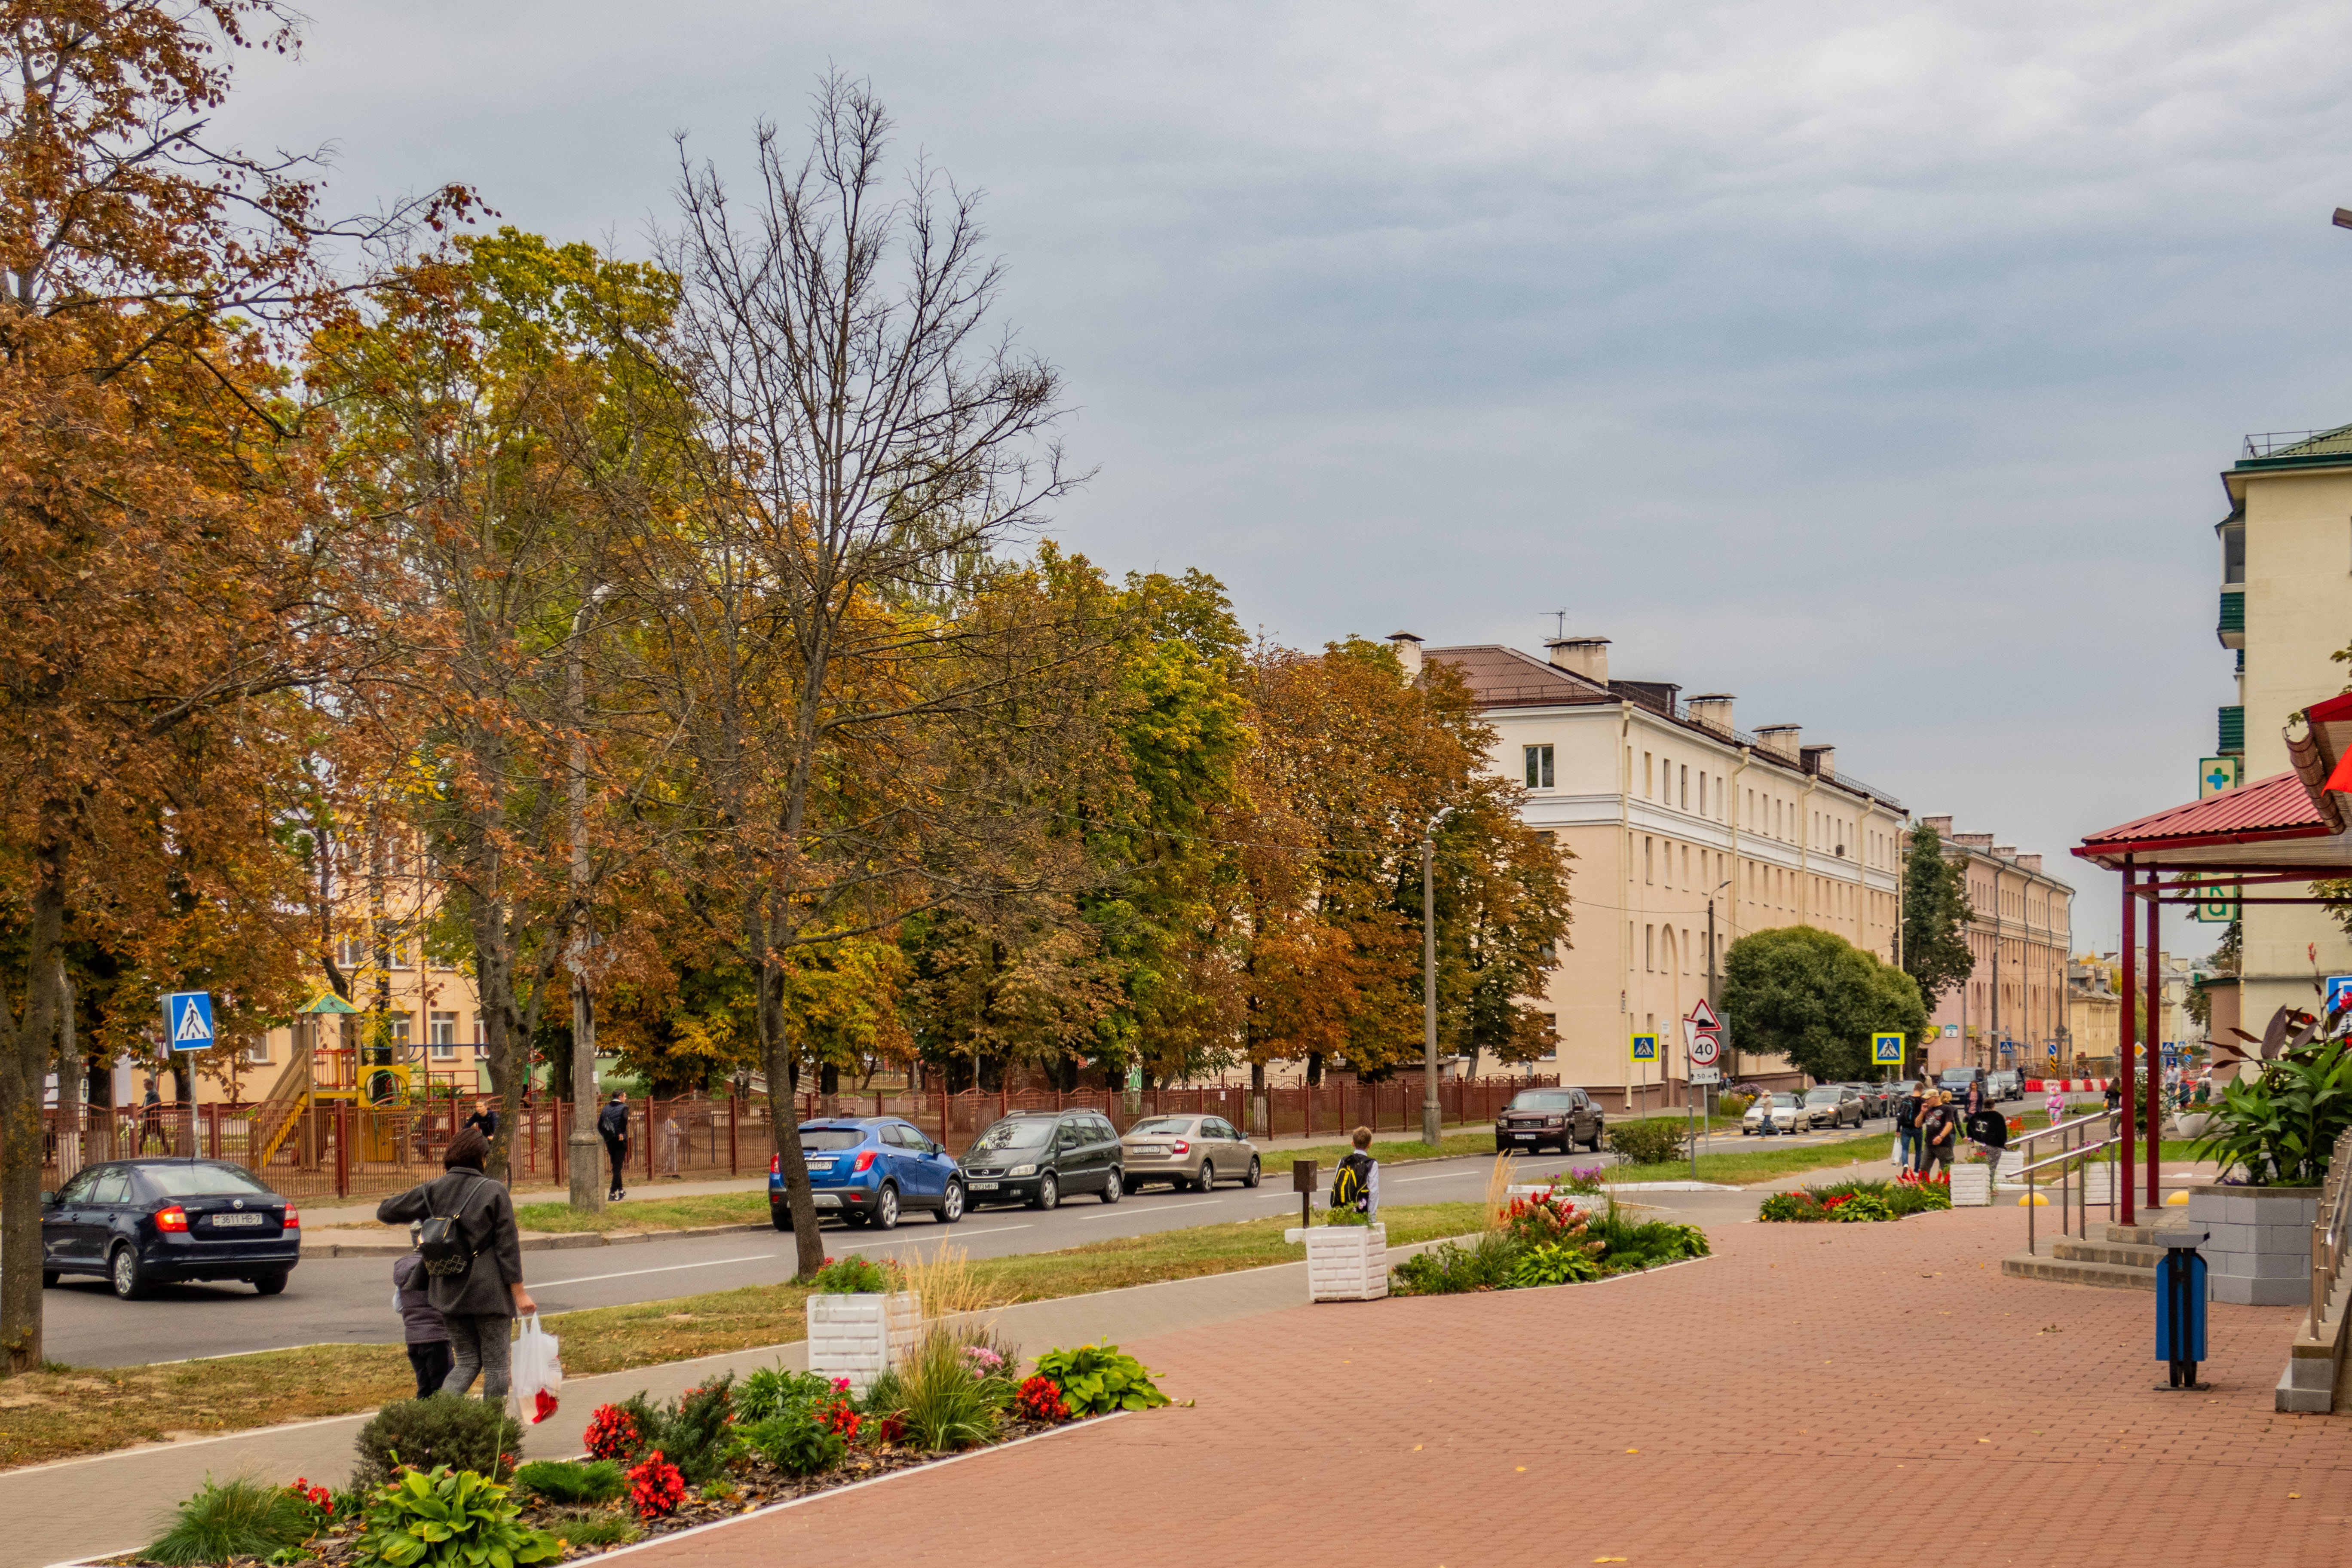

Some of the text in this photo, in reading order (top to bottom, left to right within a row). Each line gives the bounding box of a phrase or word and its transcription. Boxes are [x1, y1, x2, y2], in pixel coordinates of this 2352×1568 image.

[1695, 1044, 1713, 1056] 40
[221, 1215, 238, 1224] 3611
[242, 1214, 260, 1223] HB-7
